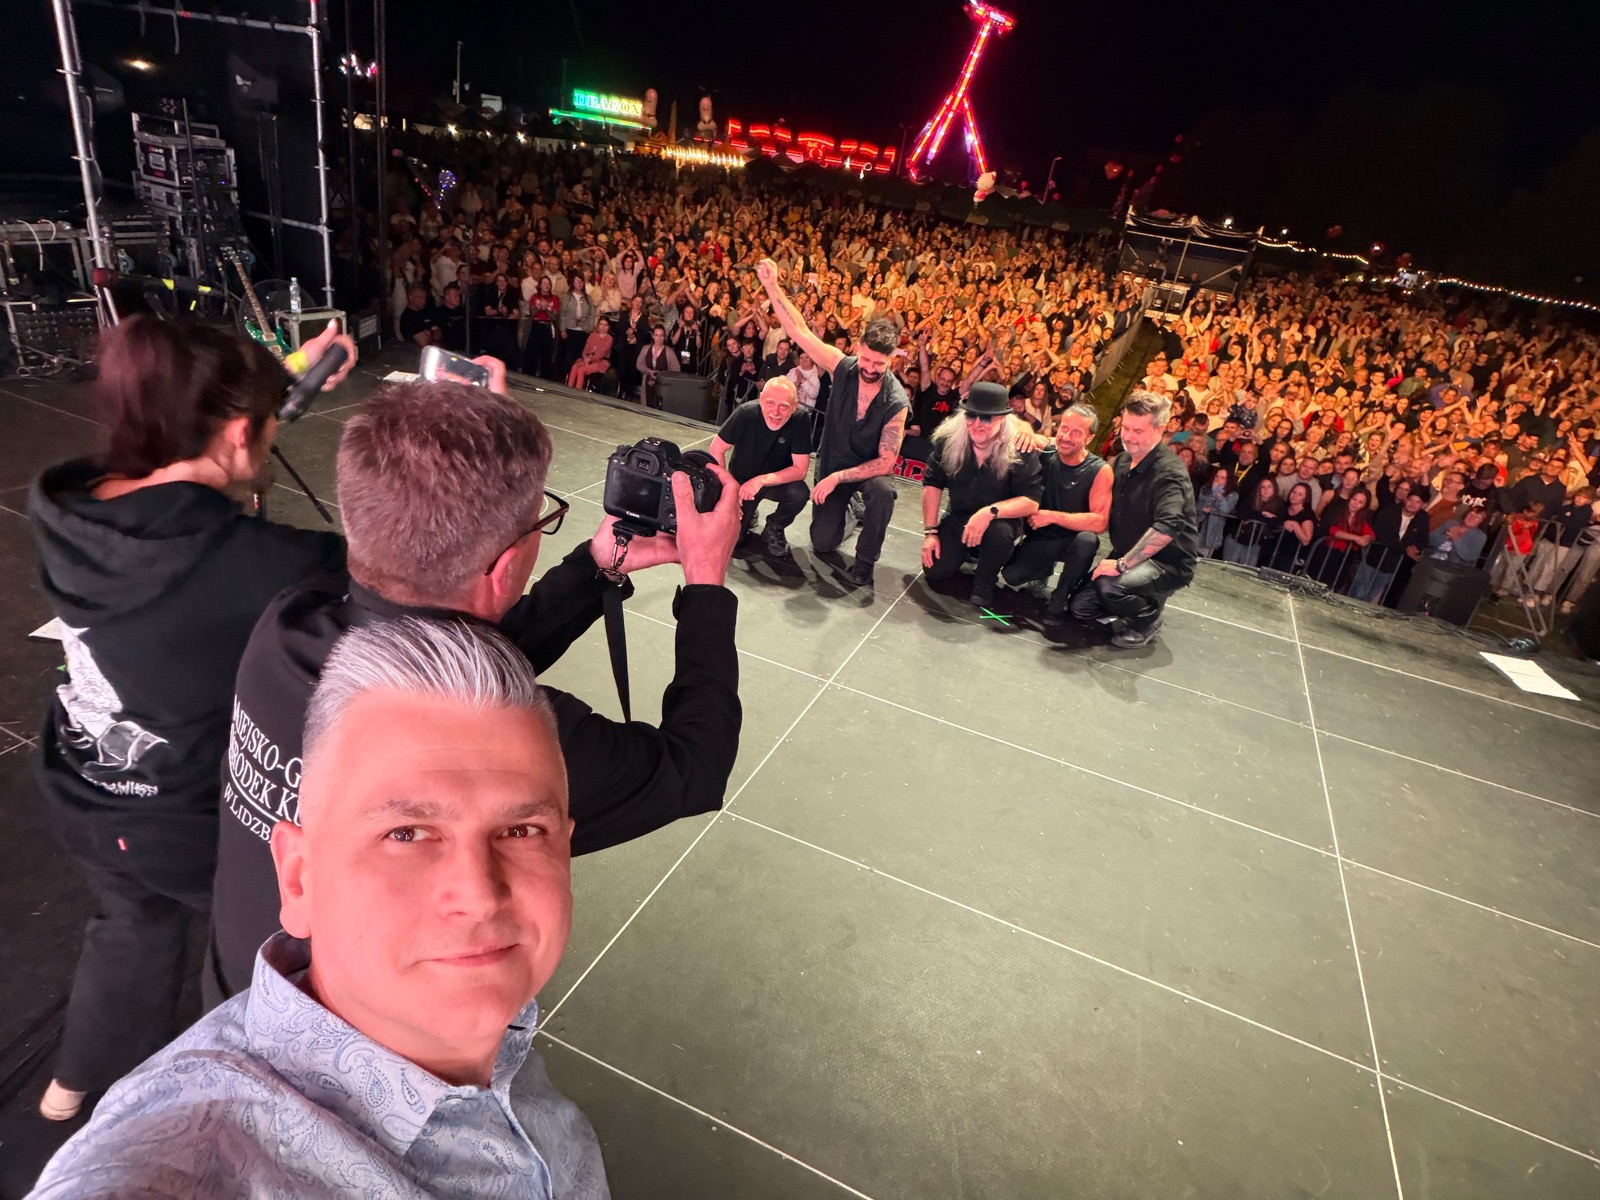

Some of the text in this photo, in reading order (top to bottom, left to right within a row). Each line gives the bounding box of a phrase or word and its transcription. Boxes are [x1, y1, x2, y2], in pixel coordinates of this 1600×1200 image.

[573, 92, 643, 117] DRAGON
[229, 723, 277, 809] RODEK
[224, 782, 271, 843] W LIDZB
